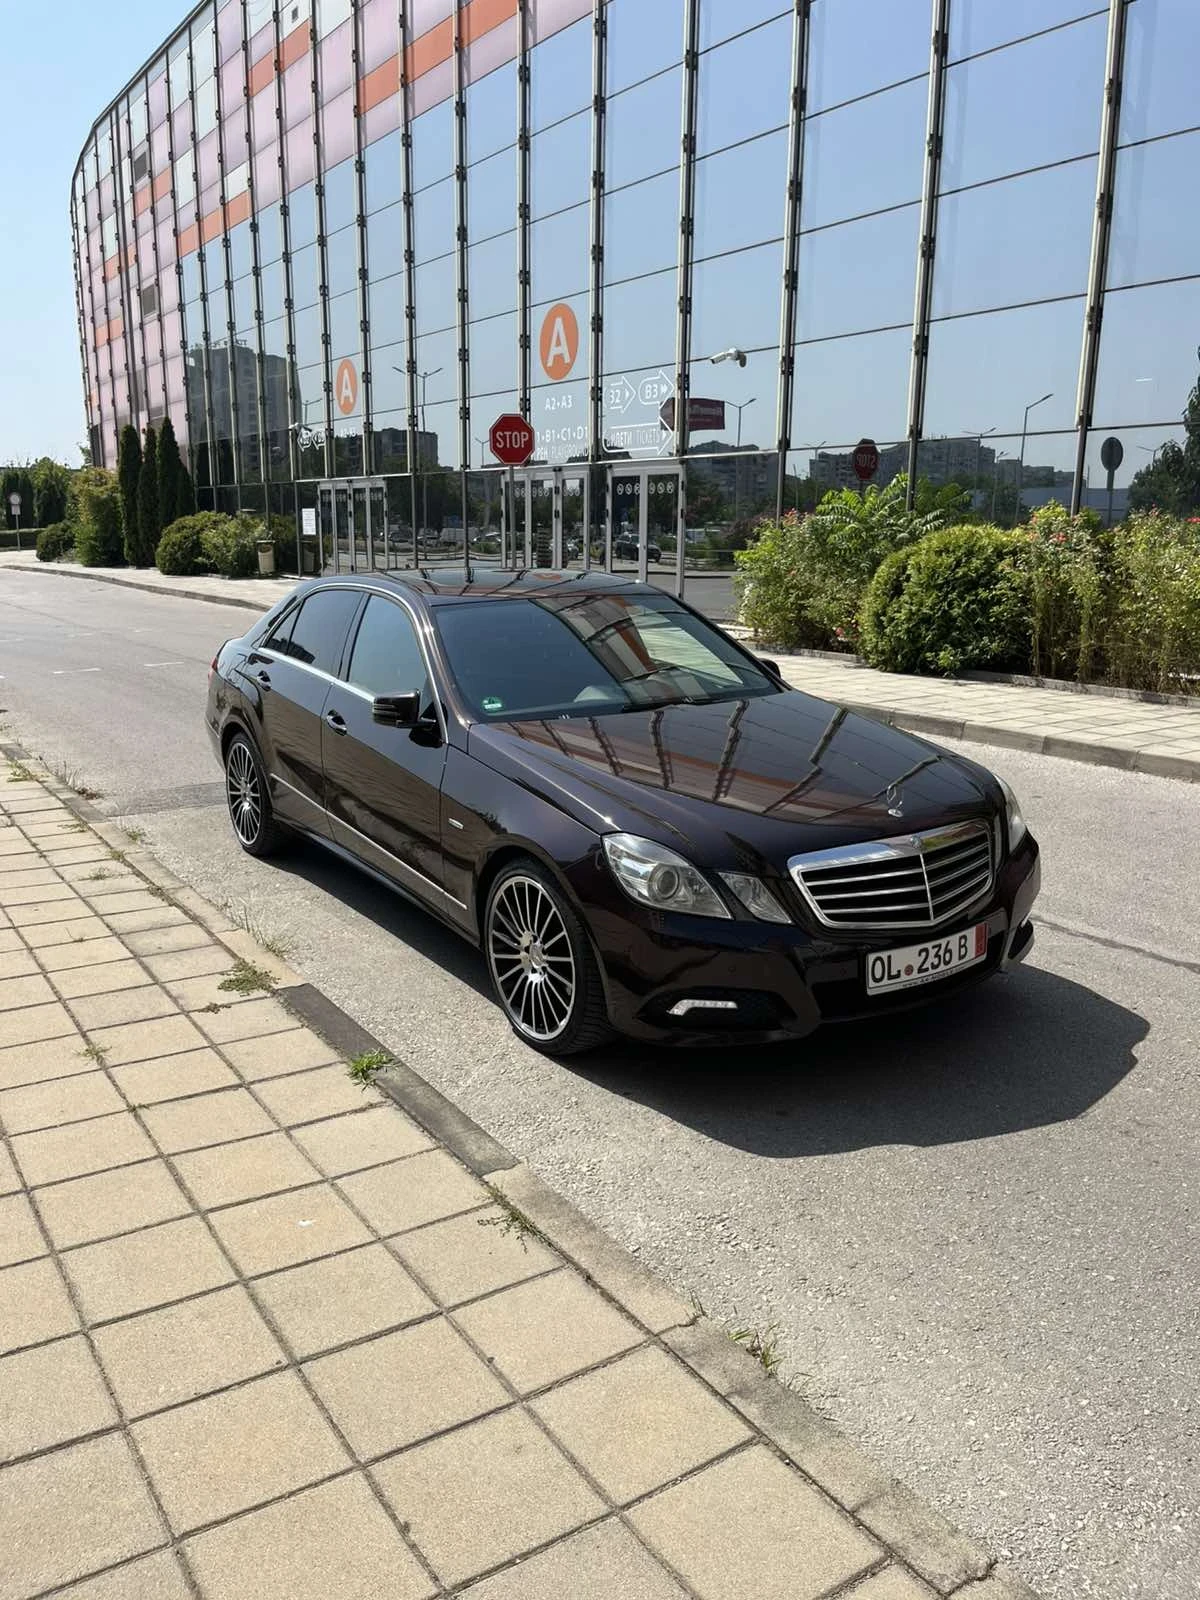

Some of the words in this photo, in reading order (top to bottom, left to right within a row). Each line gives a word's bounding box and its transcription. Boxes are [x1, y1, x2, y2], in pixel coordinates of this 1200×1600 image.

[546, 316, 571, 368] A
[340, 368, 354, 404] A
[645, 383, 659, 400] B3
[495, 431, 529, 448] STOP
[871, 954, 901, 983] OL
[917, 940, 953, 974] 236
[958, 934, 968, 960] B
